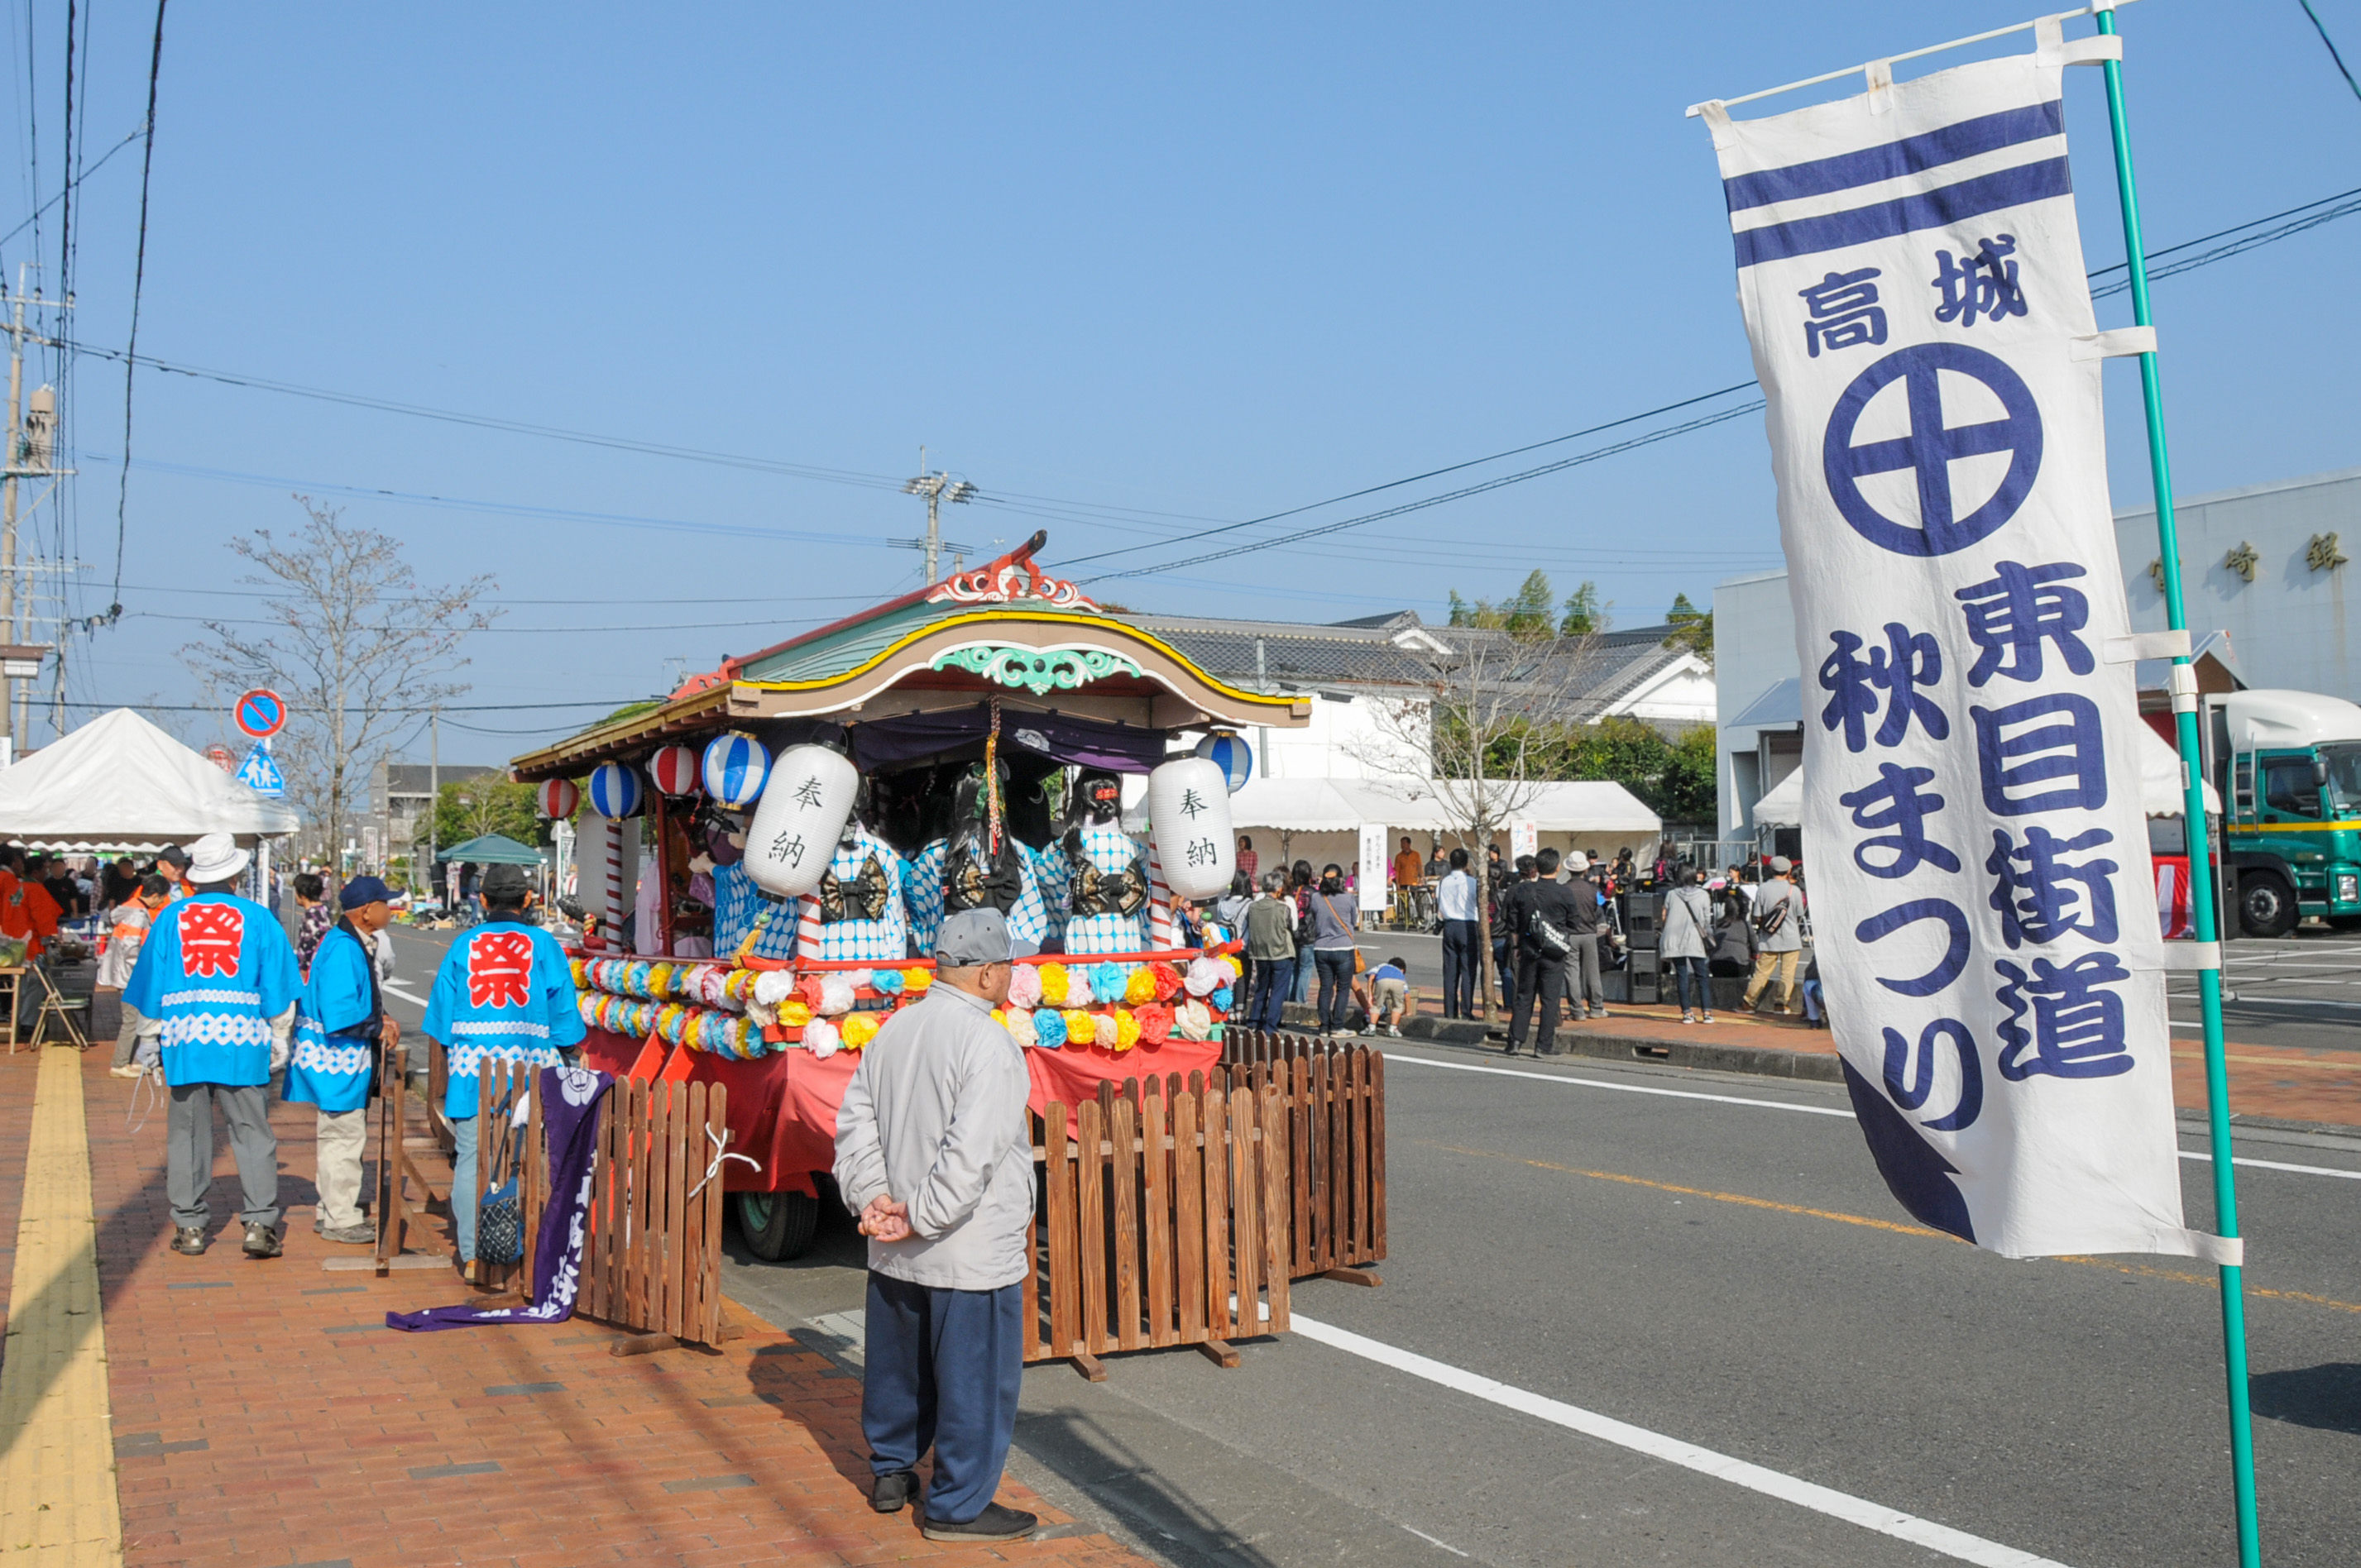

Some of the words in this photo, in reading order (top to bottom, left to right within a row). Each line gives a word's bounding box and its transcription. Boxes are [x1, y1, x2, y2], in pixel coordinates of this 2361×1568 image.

[1798, 233, 2029, 358] 高城
[768, 775, 823, 869] 奉納
[1178, 788, 1217, 868] 奉納
[1956, 561, 2135, 1083] 東目街道
[1819, 622, 1984, 1132] 秋まつり
[177, 901, 245, 978] 祭
[467, 930, 534, 1010] 祭
